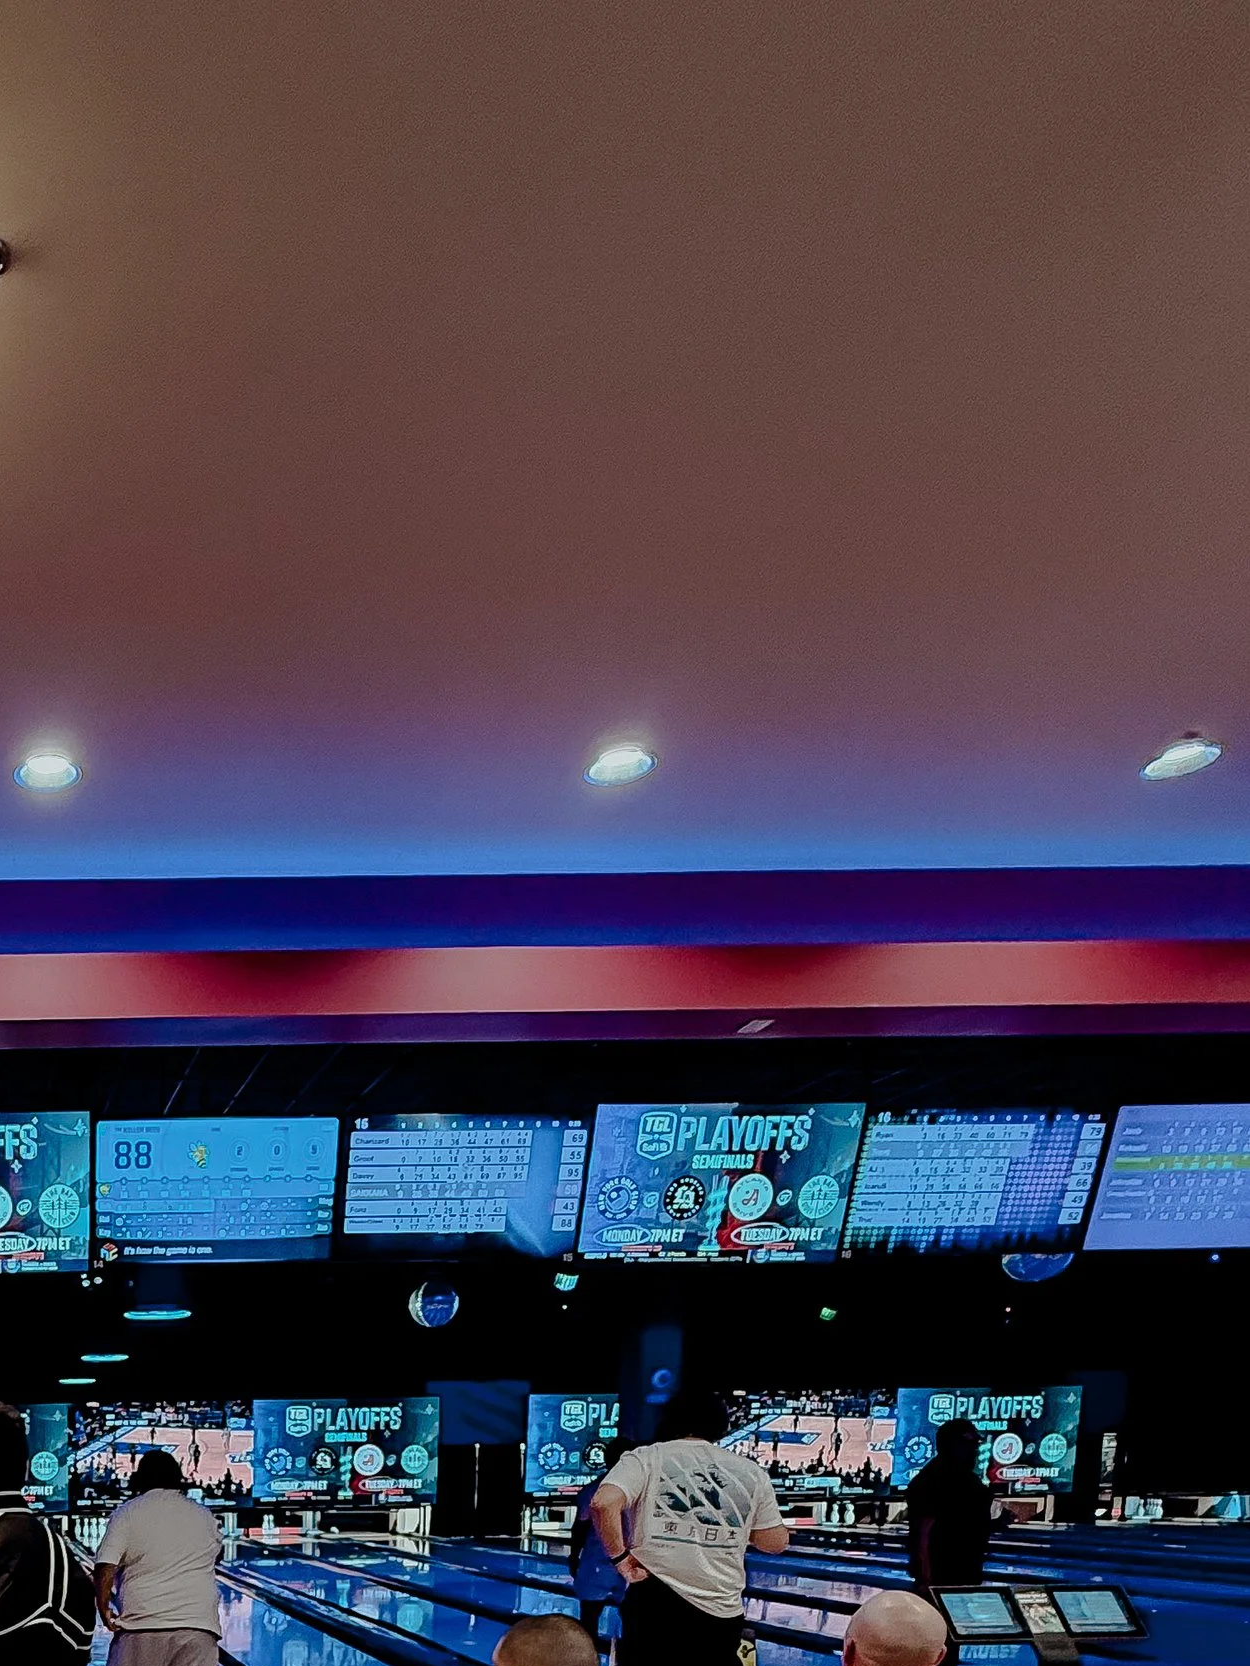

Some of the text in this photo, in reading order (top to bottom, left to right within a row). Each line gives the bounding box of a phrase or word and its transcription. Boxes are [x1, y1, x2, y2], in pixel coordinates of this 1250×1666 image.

[355, 1118, 369, 1129] 15
[645, 1117, 672, 1132] TGL
[572, 1134, 584, 1143] 69
[677, 1115, 811, 1151] PLAYOFFS
[115, 1141, 151, 1169] 88
[570, 1151, 582, 1160] 55
[692, 1154, 754, 1169] SEMIFINALS
[602, 1229, 685, 1242] MONDAY 7PM ET
[741, 1228, 824, 1241] TUESDAY 7PM ET
[36, 1237, 57, 1250] 7PM
[58, 1237, 70, 1250] ET
[955, 1395, 1044, 1419] PLAYOFFS
[314, 1407, 402, 1431] PLAYOFFS
[325, 1432, 367, 1443] SEMIFINALS
